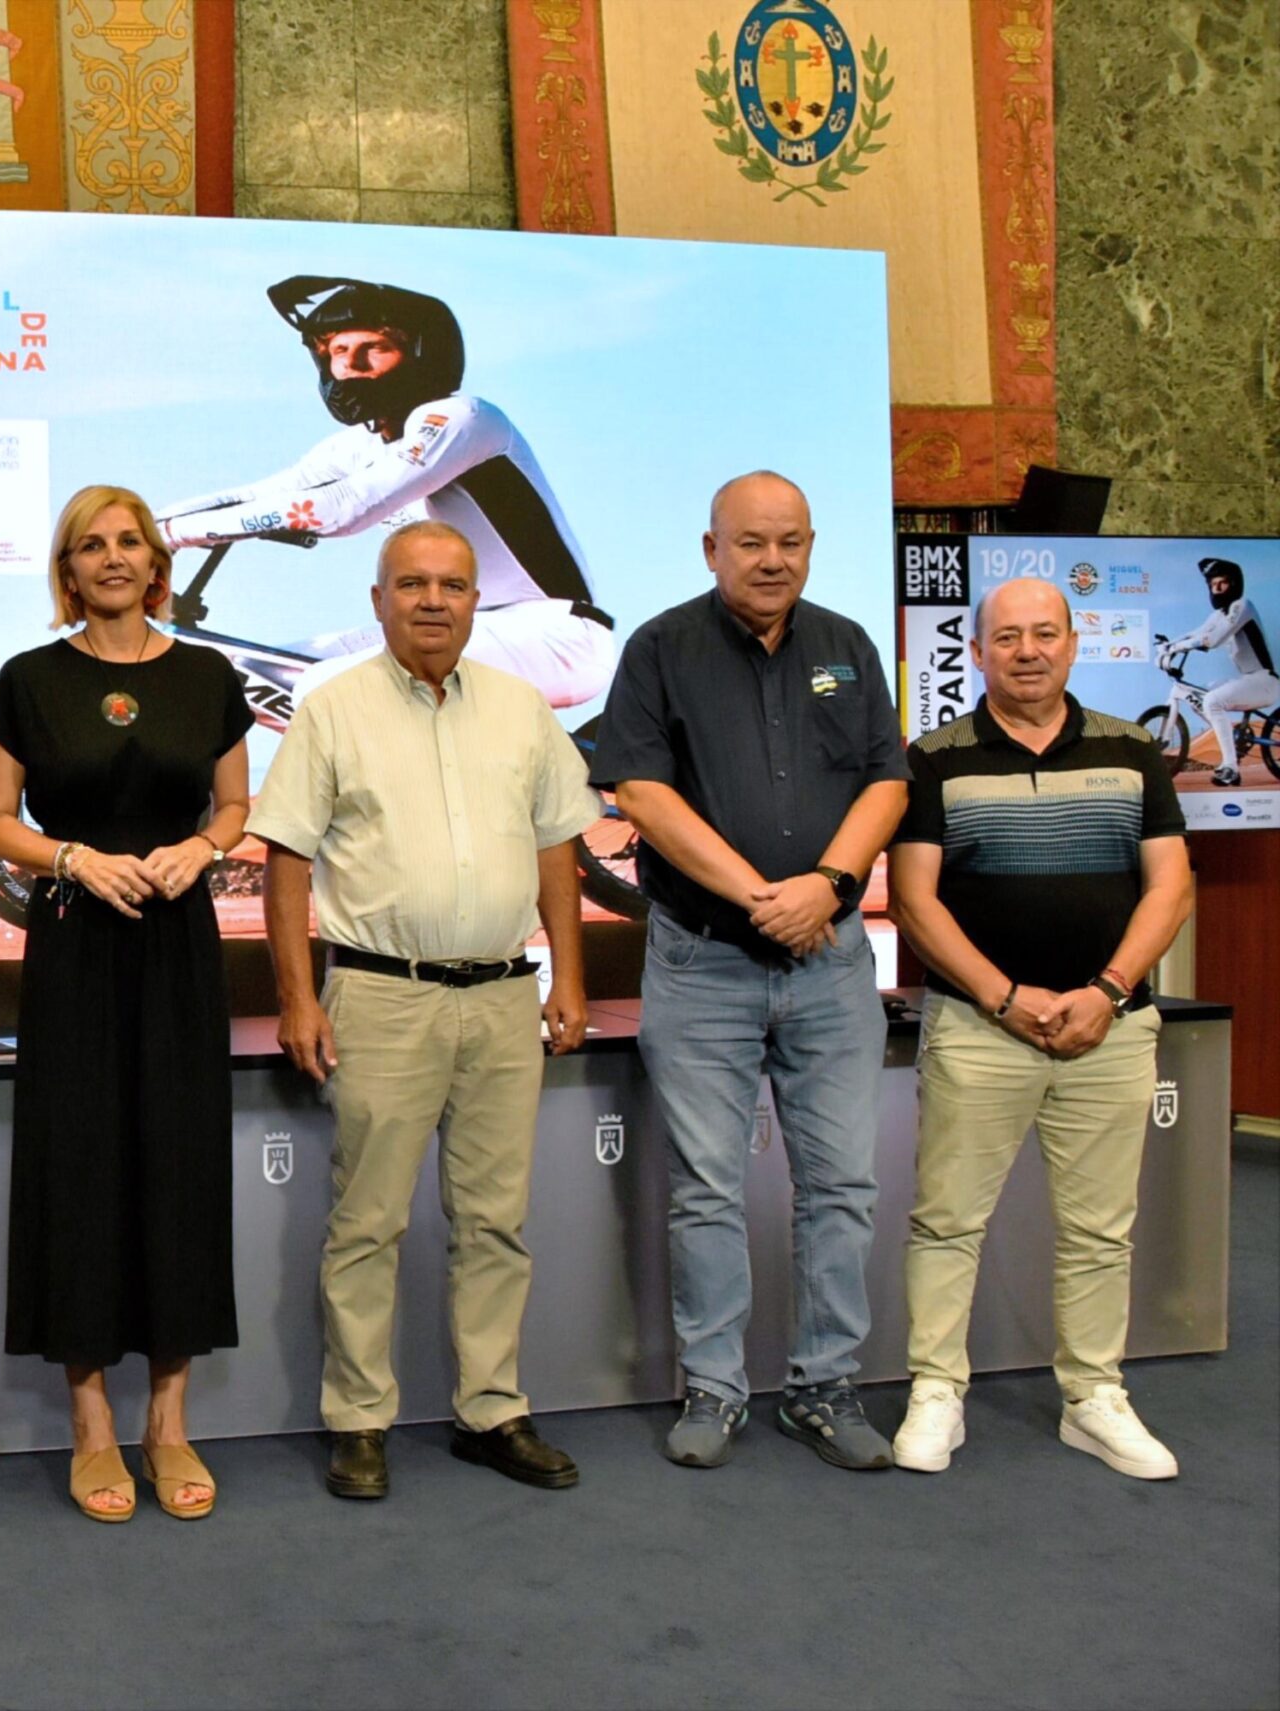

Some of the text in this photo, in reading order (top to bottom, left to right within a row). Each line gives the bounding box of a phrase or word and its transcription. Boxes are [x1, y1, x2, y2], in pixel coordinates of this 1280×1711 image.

[21, 312, 47, 348] DE
[240, 510, 282, 532] Islas
[905, 546, 962, 570] BMX
[979, 549, 1056, 578] 19/20
[1085, 777, 1121, 785] BOSS
